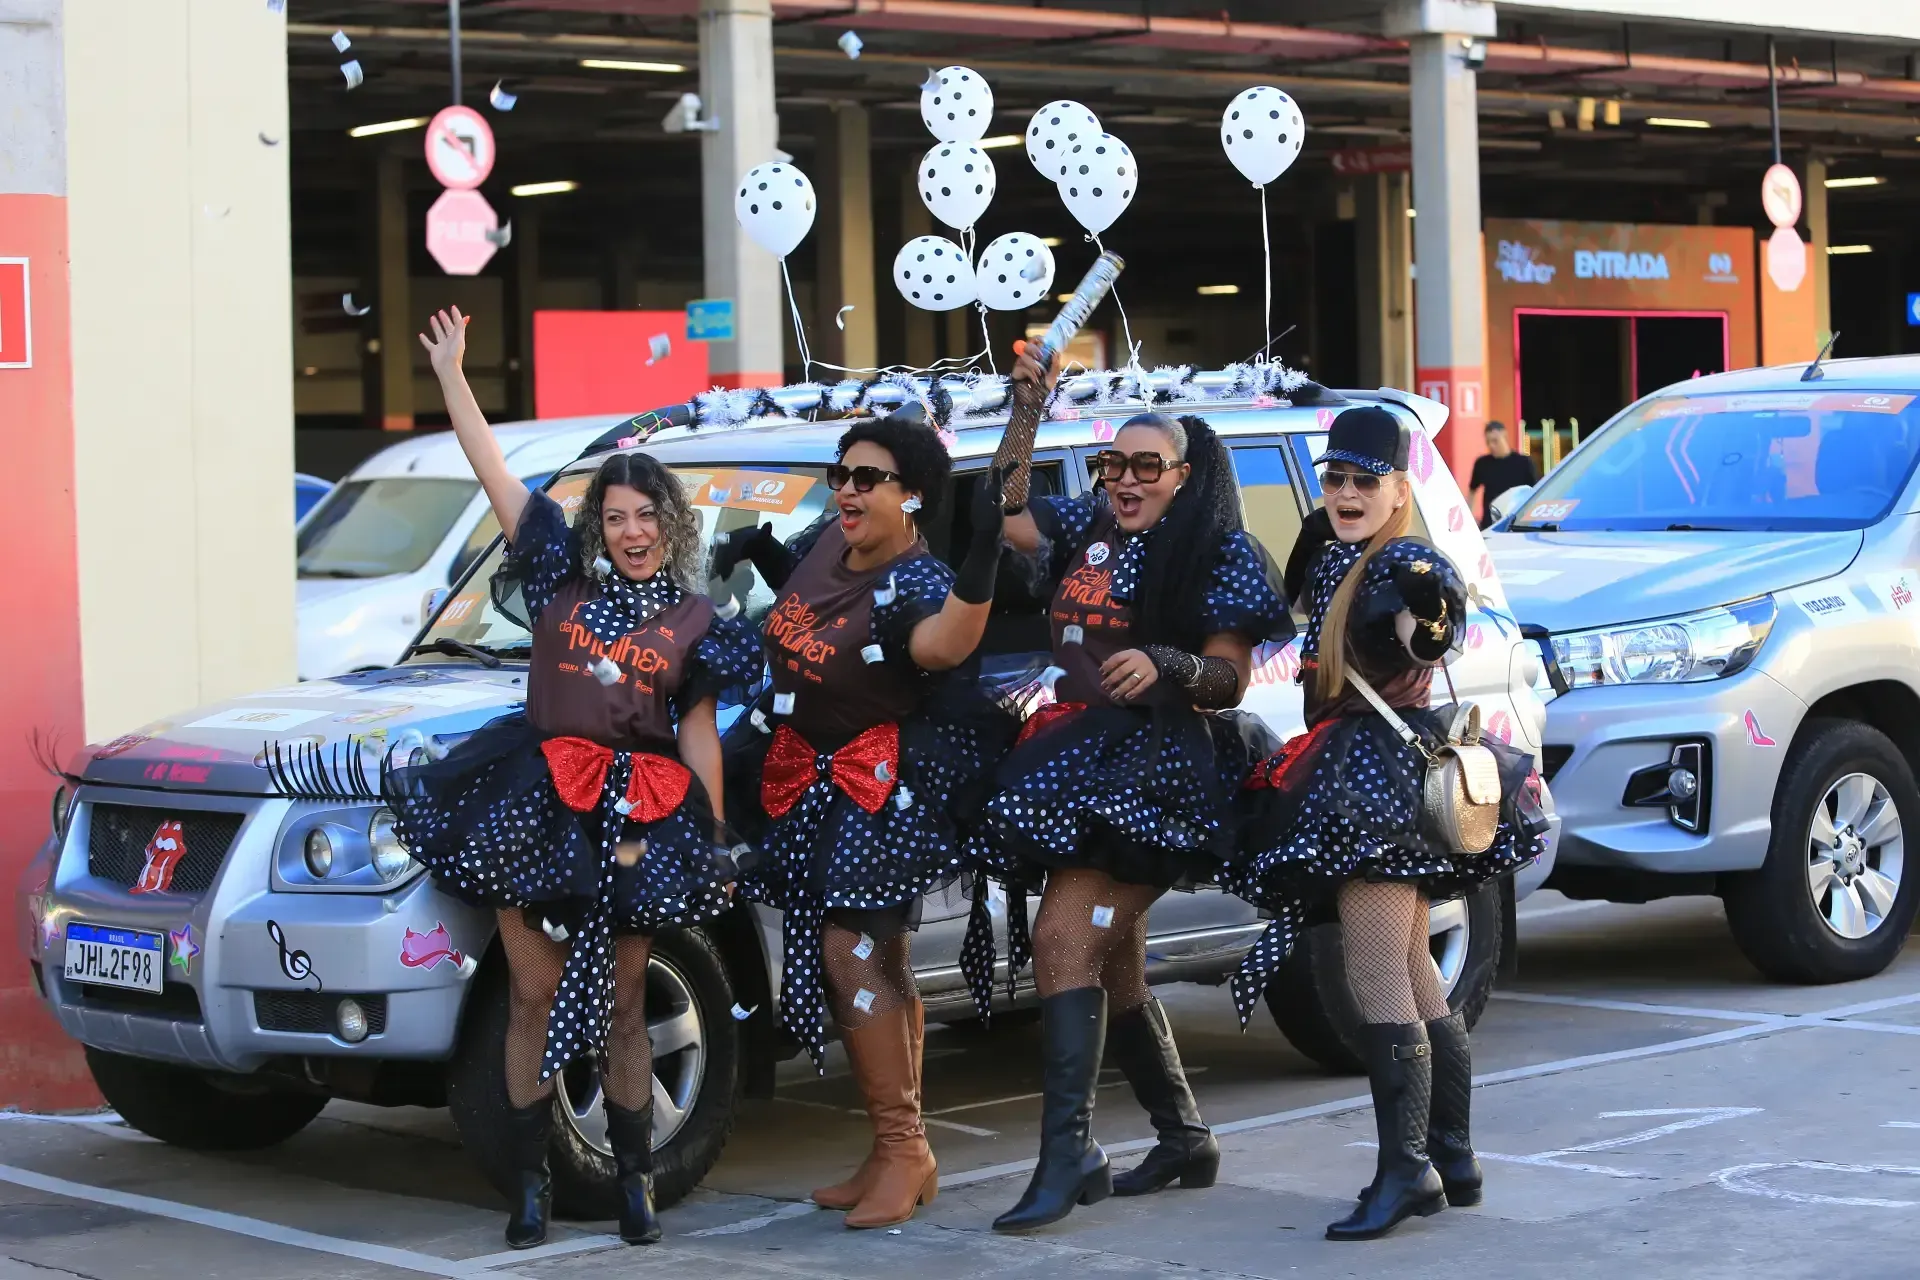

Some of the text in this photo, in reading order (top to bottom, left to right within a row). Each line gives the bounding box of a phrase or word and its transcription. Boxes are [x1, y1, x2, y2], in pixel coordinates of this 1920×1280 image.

[1574, 250, 1669, 280] ENTRADA
[1530, 503, 1573, 518] 036
[1062, 579, 1124, 610] Mulh
[1802, 595, 1846, 614] VOLCANO
[560, 619, 573, 633] da
[569, 623, 669, 675] Mulher
[767, 613, 837, 664] Mulher
[108, 933, 125, 944] BRASIL
[74, 943, 152, 985] JHL2F98
